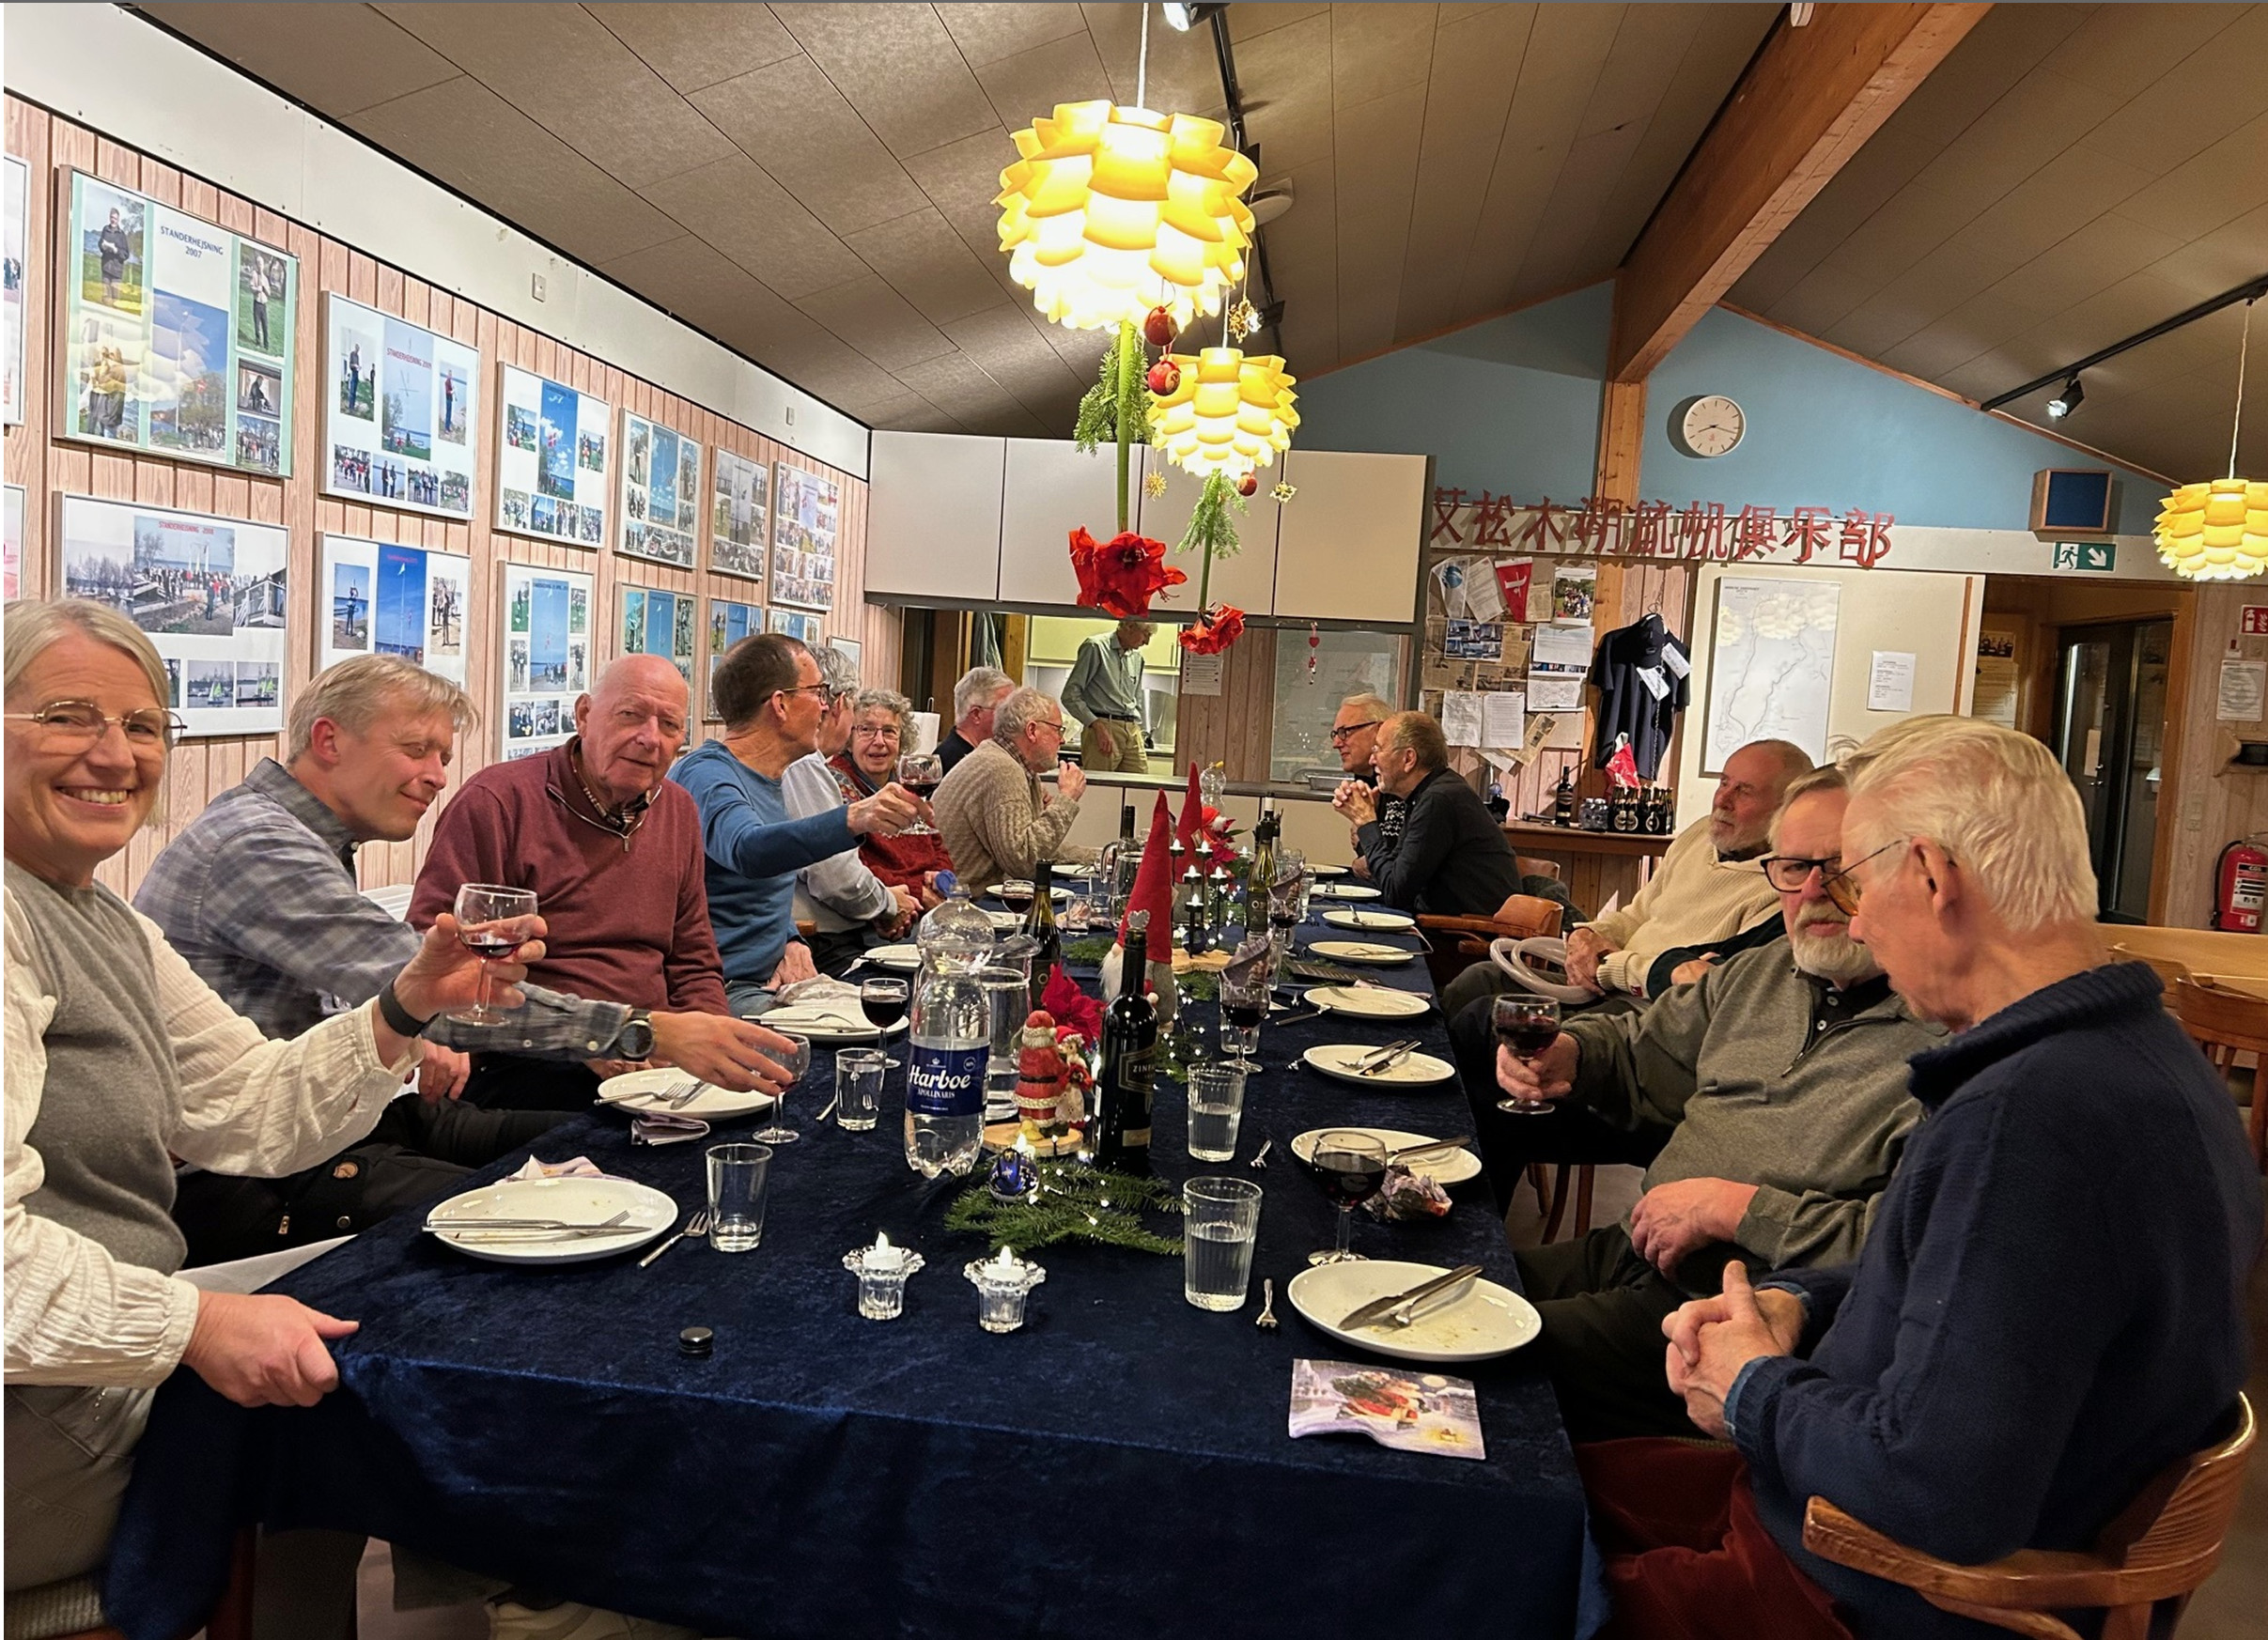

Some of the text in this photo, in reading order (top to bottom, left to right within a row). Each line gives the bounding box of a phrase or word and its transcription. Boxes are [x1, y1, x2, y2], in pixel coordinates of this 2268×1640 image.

[161, 226, 224, 255] STANDERHEJSNING
[186, 246, 202, 258] 2007
[909, 1064, 971, 1090] Harboe
[918, 1088, 955, 1098] APOLLINARIS
